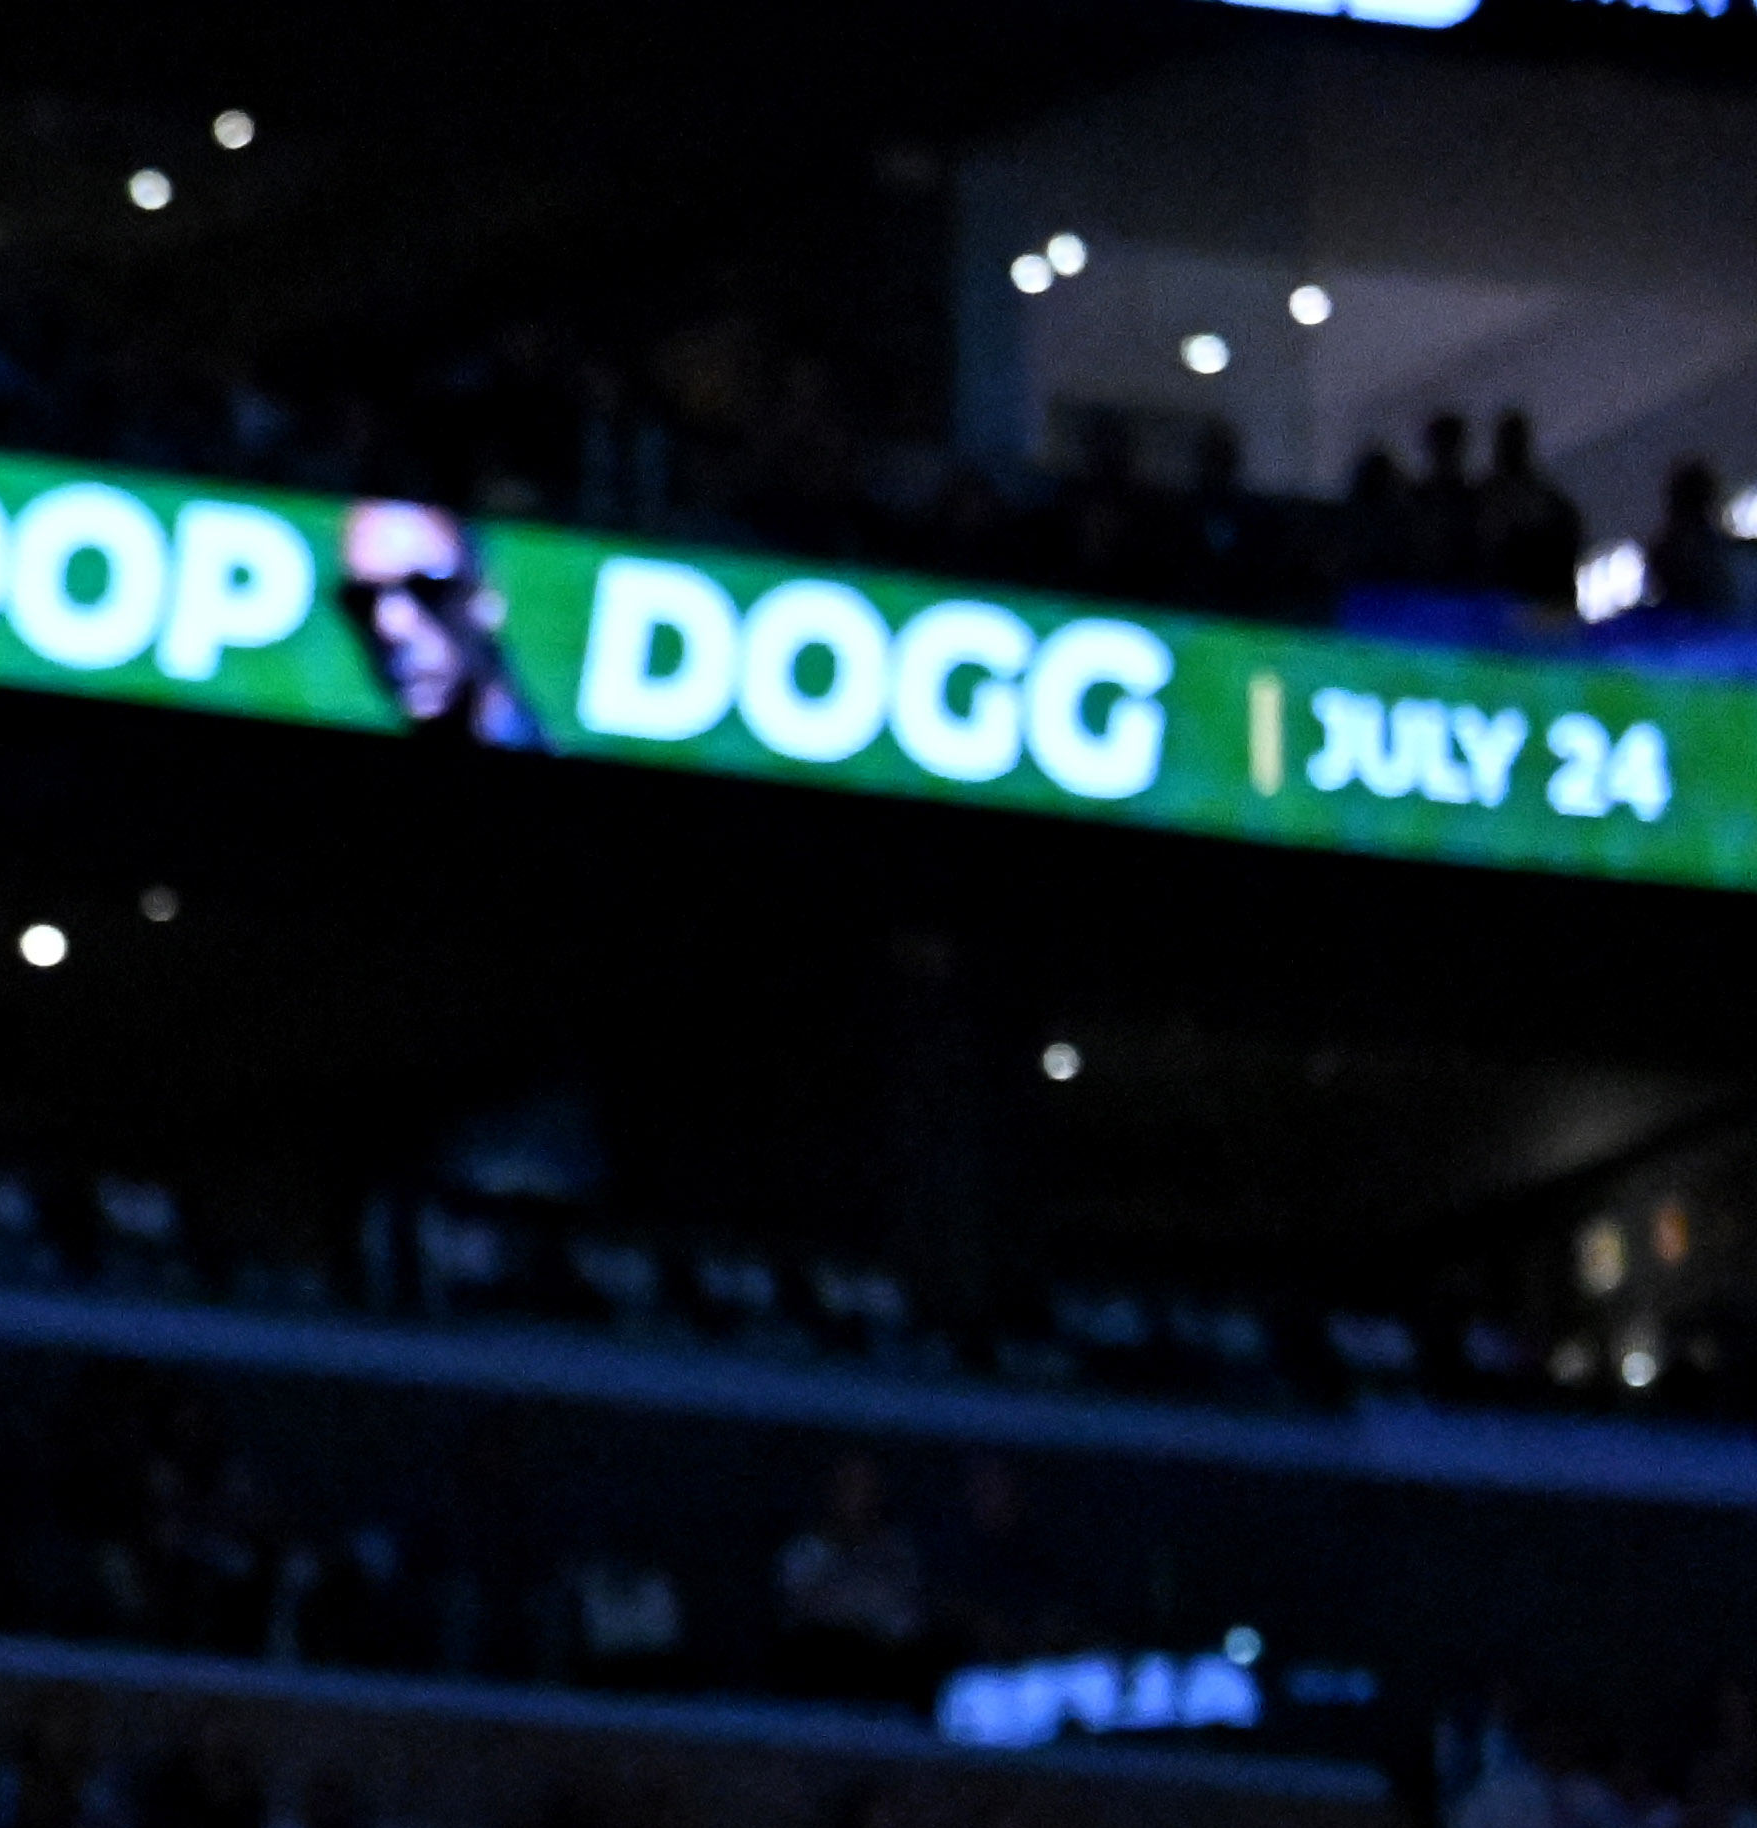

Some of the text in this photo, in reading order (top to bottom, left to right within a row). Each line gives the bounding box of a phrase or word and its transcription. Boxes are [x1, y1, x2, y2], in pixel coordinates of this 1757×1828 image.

[576, 556, 1175, 800] DOGG
[1306, 686, 1528, 808] JULY
[1545, 711, 1672, 823] 24
